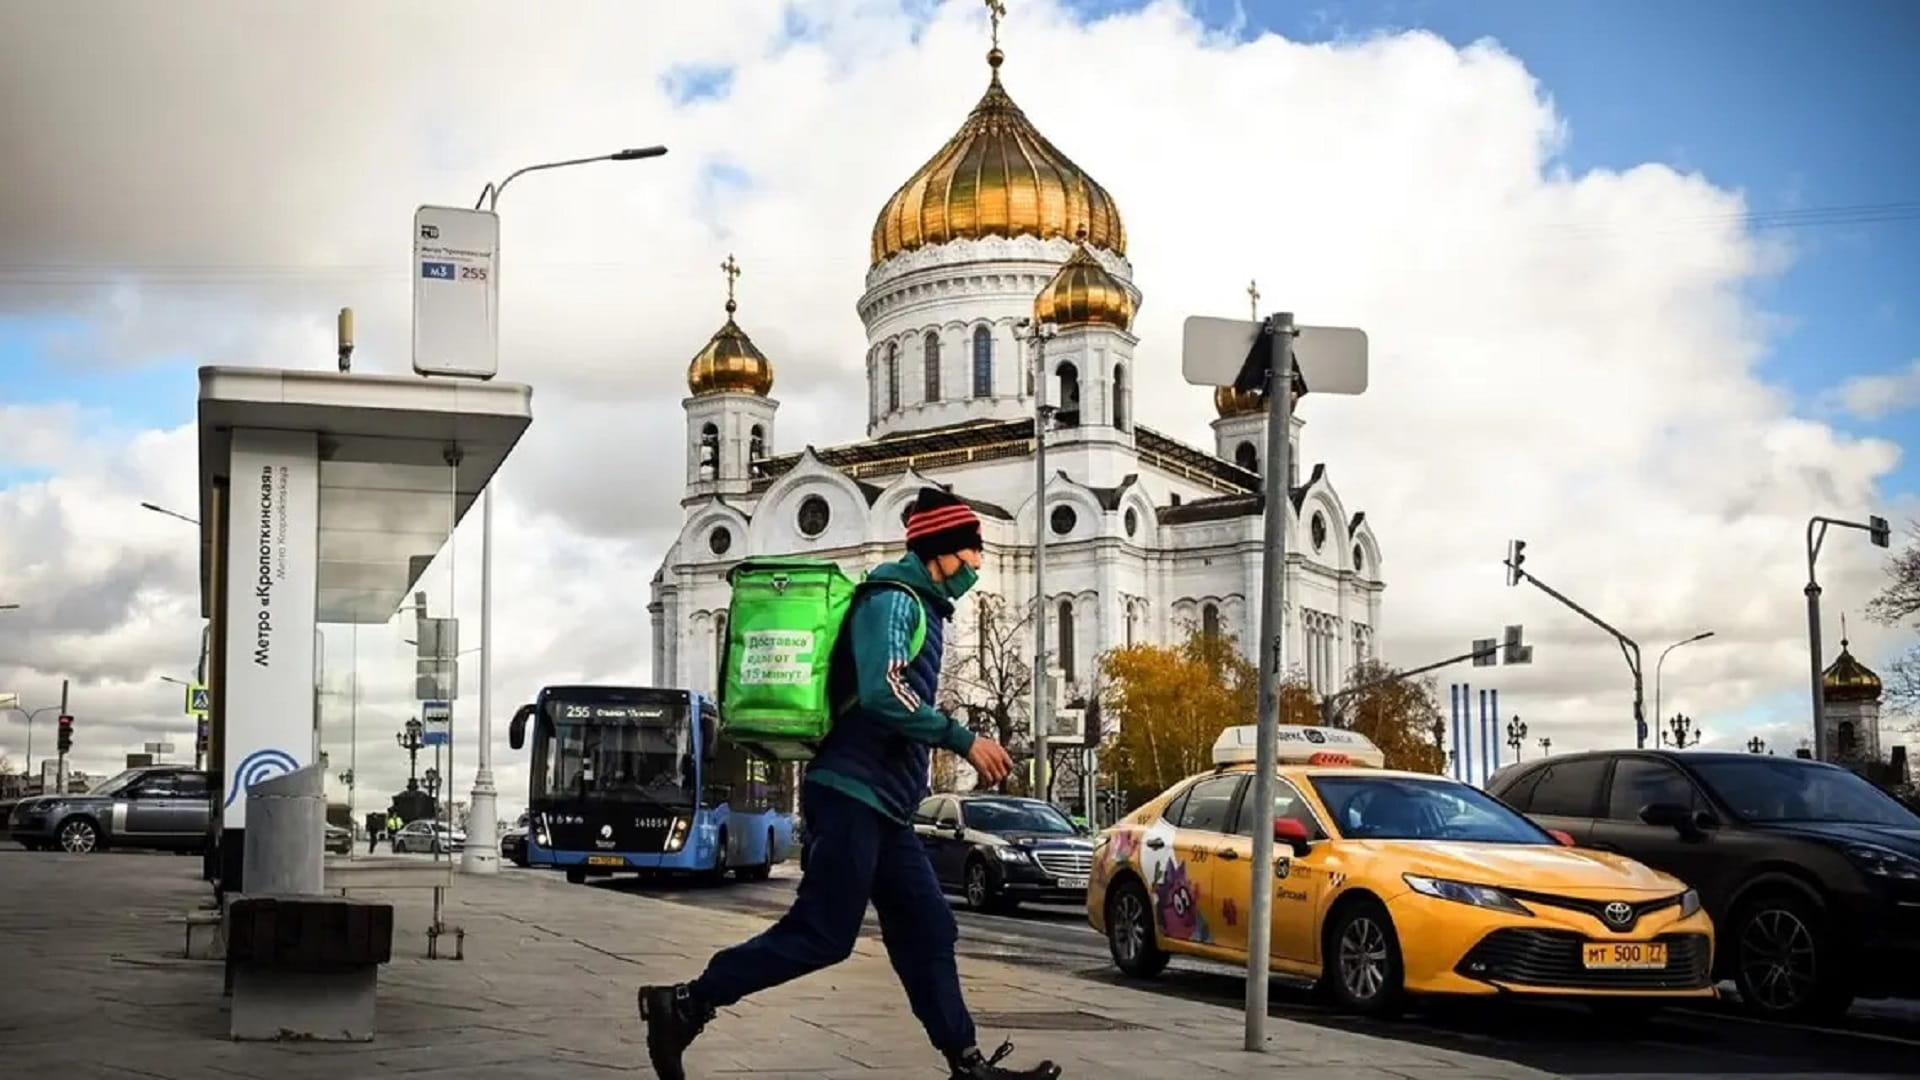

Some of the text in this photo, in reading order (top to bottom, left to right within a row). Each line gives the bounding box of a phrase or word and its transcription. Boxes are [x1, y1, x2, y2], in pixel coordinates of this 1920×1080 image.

[462, 267, 487, 280] 255
[254, 465, 274, 667] Метро «Кропоткинская»
[277, 548, 286, 580] Metro
[749, 636, 807, 649] Доставка
[774, 654, 790, 663] от
[746, 668, 802, 681] 15 минут
[566, 705, 590, 718] 255
[1615, 945, 1641, 962] 500
